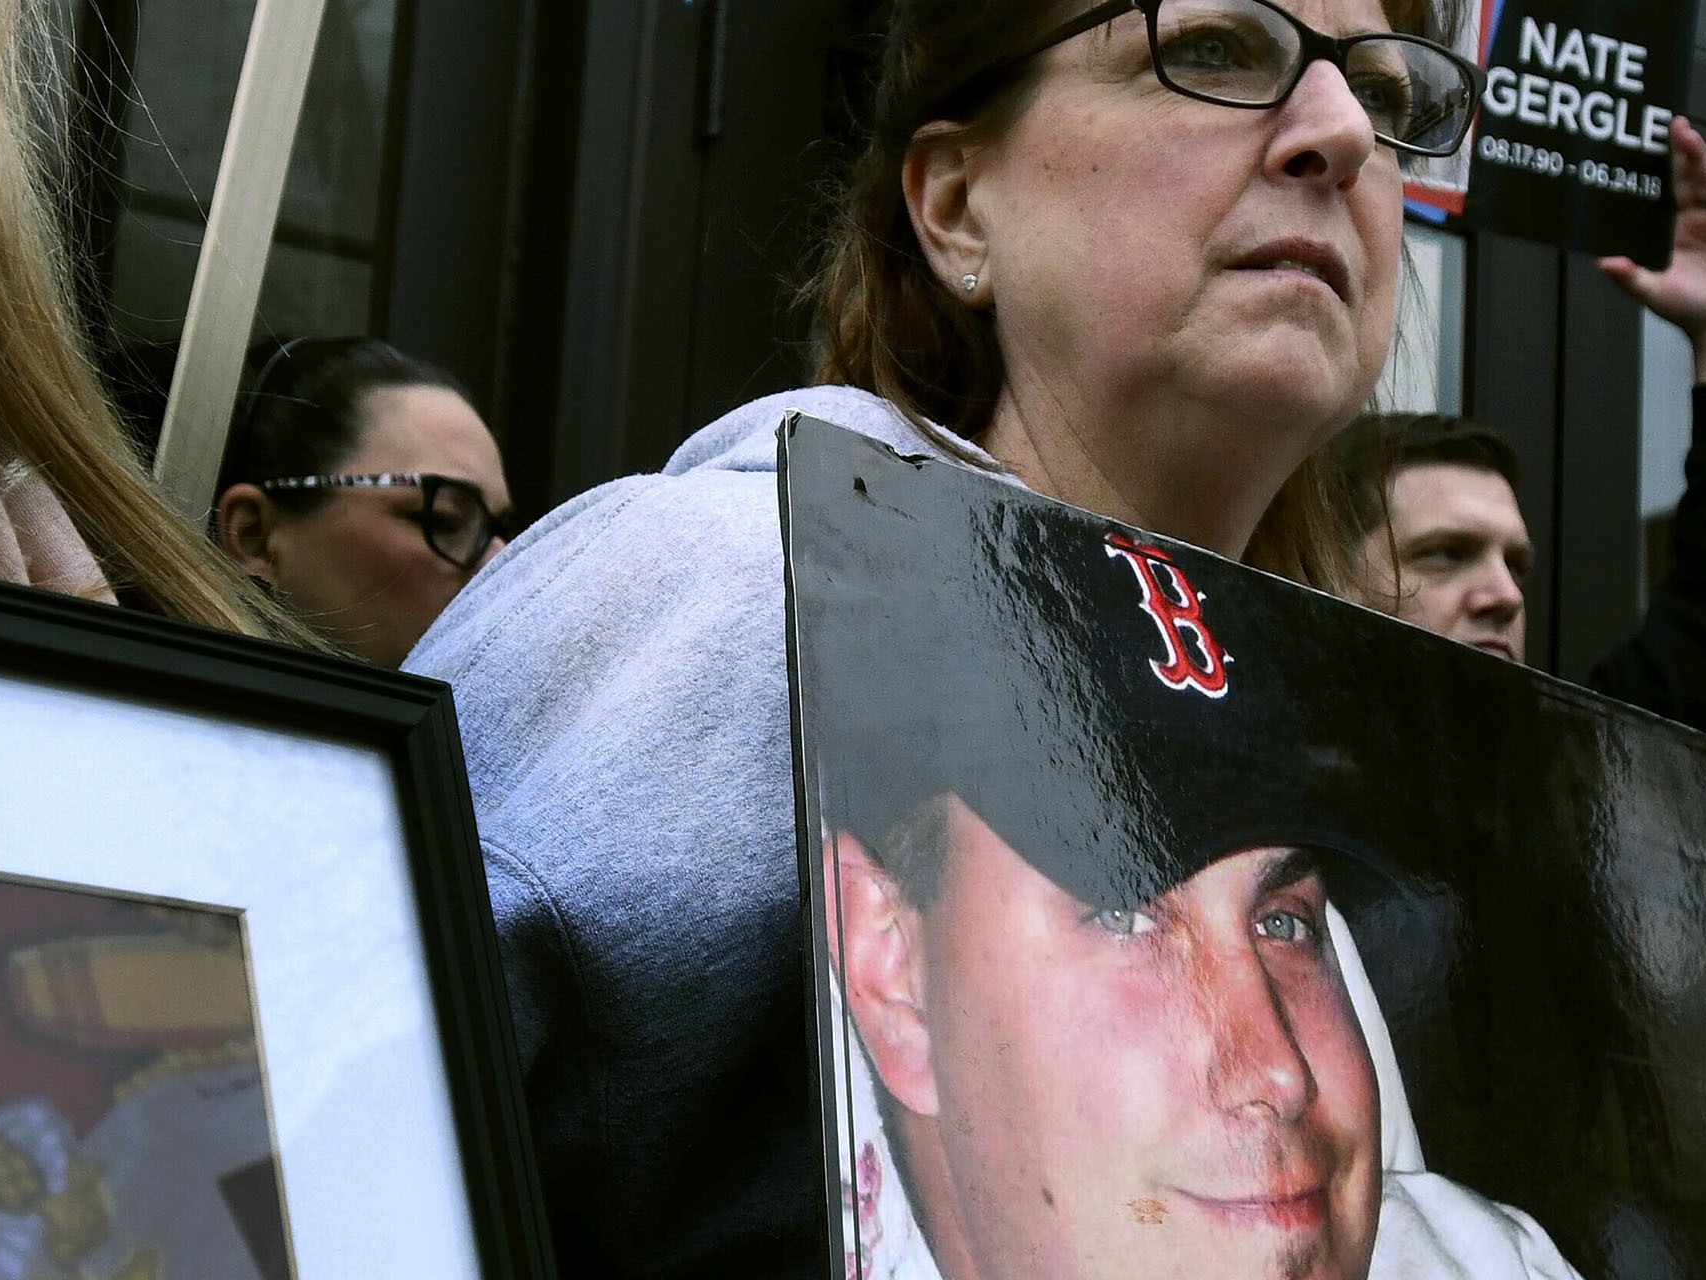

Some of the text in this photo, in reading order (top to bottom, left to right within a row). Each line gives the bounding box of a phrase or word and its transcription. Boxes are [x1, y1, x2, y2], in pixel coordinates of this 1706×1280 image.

[1518, 16, 1648, 94] NATE
[1483, 66, 1670, 153] GERGLE
[1104, 534, 1234, 699] B
